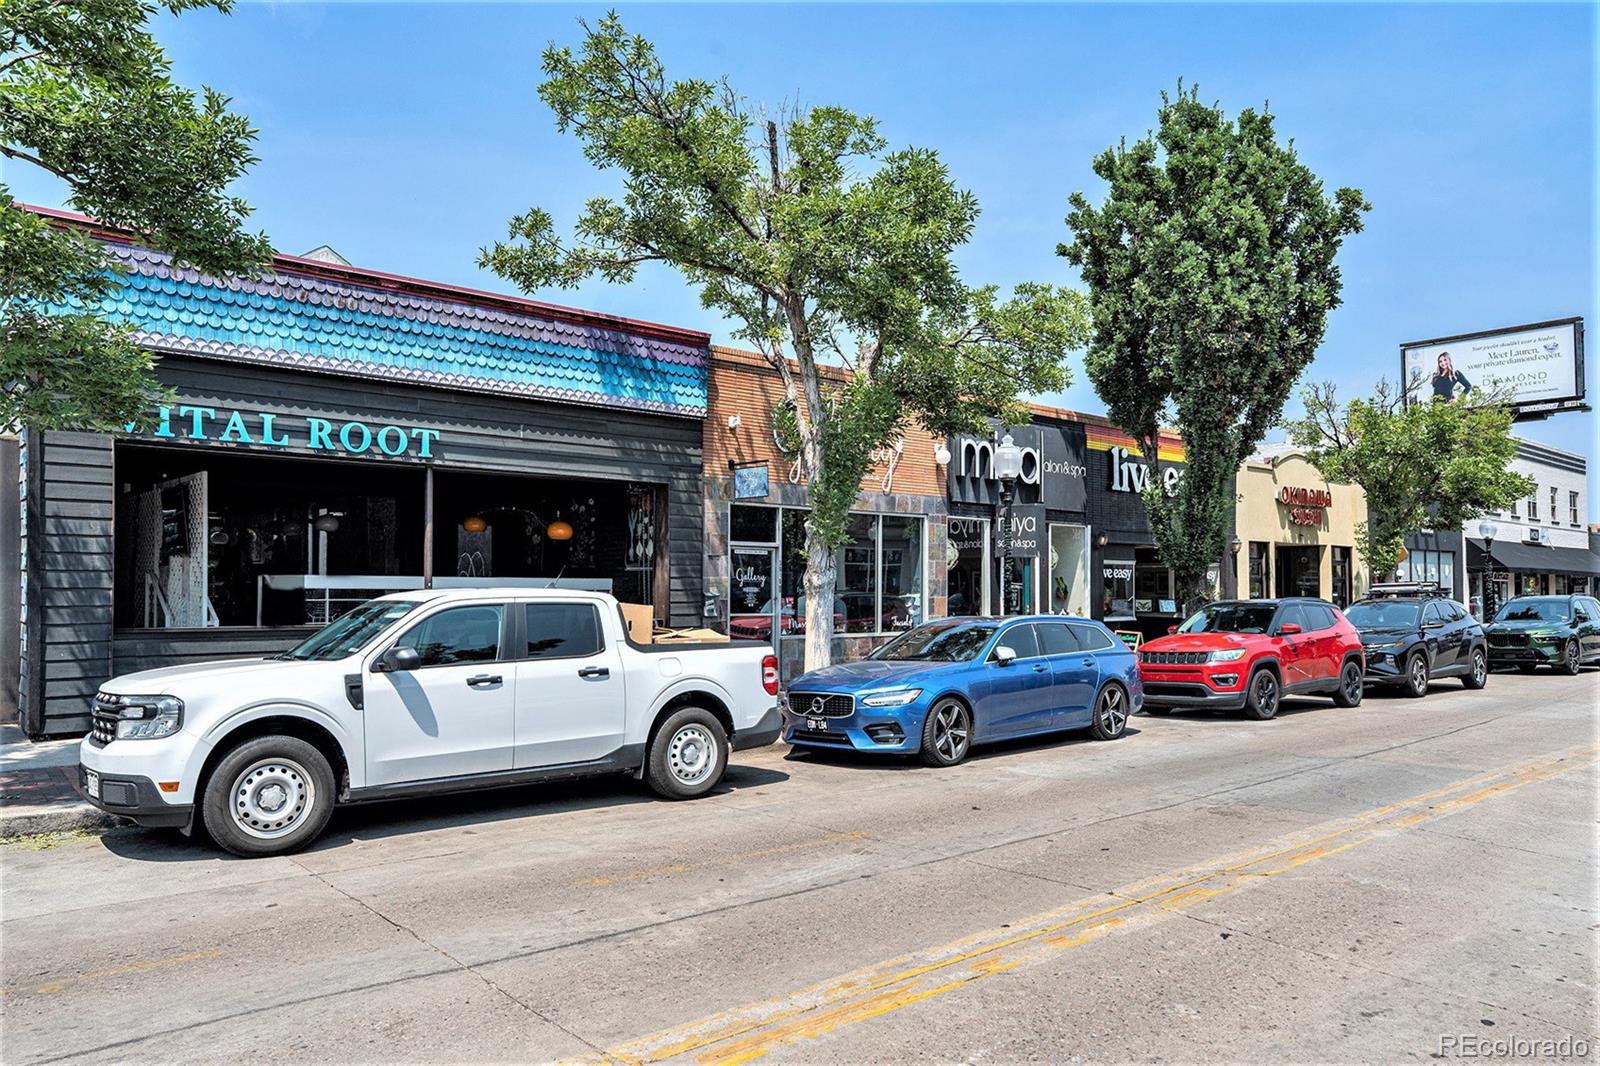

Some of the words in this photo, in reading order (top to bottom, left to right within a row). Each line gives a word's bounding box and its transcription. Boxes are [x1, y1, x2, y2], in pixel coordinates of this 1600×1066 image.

[1467, 363, 1482, 371] your
[1483, 359, 1505, 369] private
[1507, 354, 1537, 364] diamond
[1488, 351, 1508, 360] Meet
[121, 404, 288, 446] ITAL
[306, 417, 440, 458] ROOT
[1043, 459, 1087, 478] alon&spa
[1291, 508, 1323, 525] SUSHI
[735, 566, 767, 587] Gallery
[1113, 569, 1132, 581] easy
